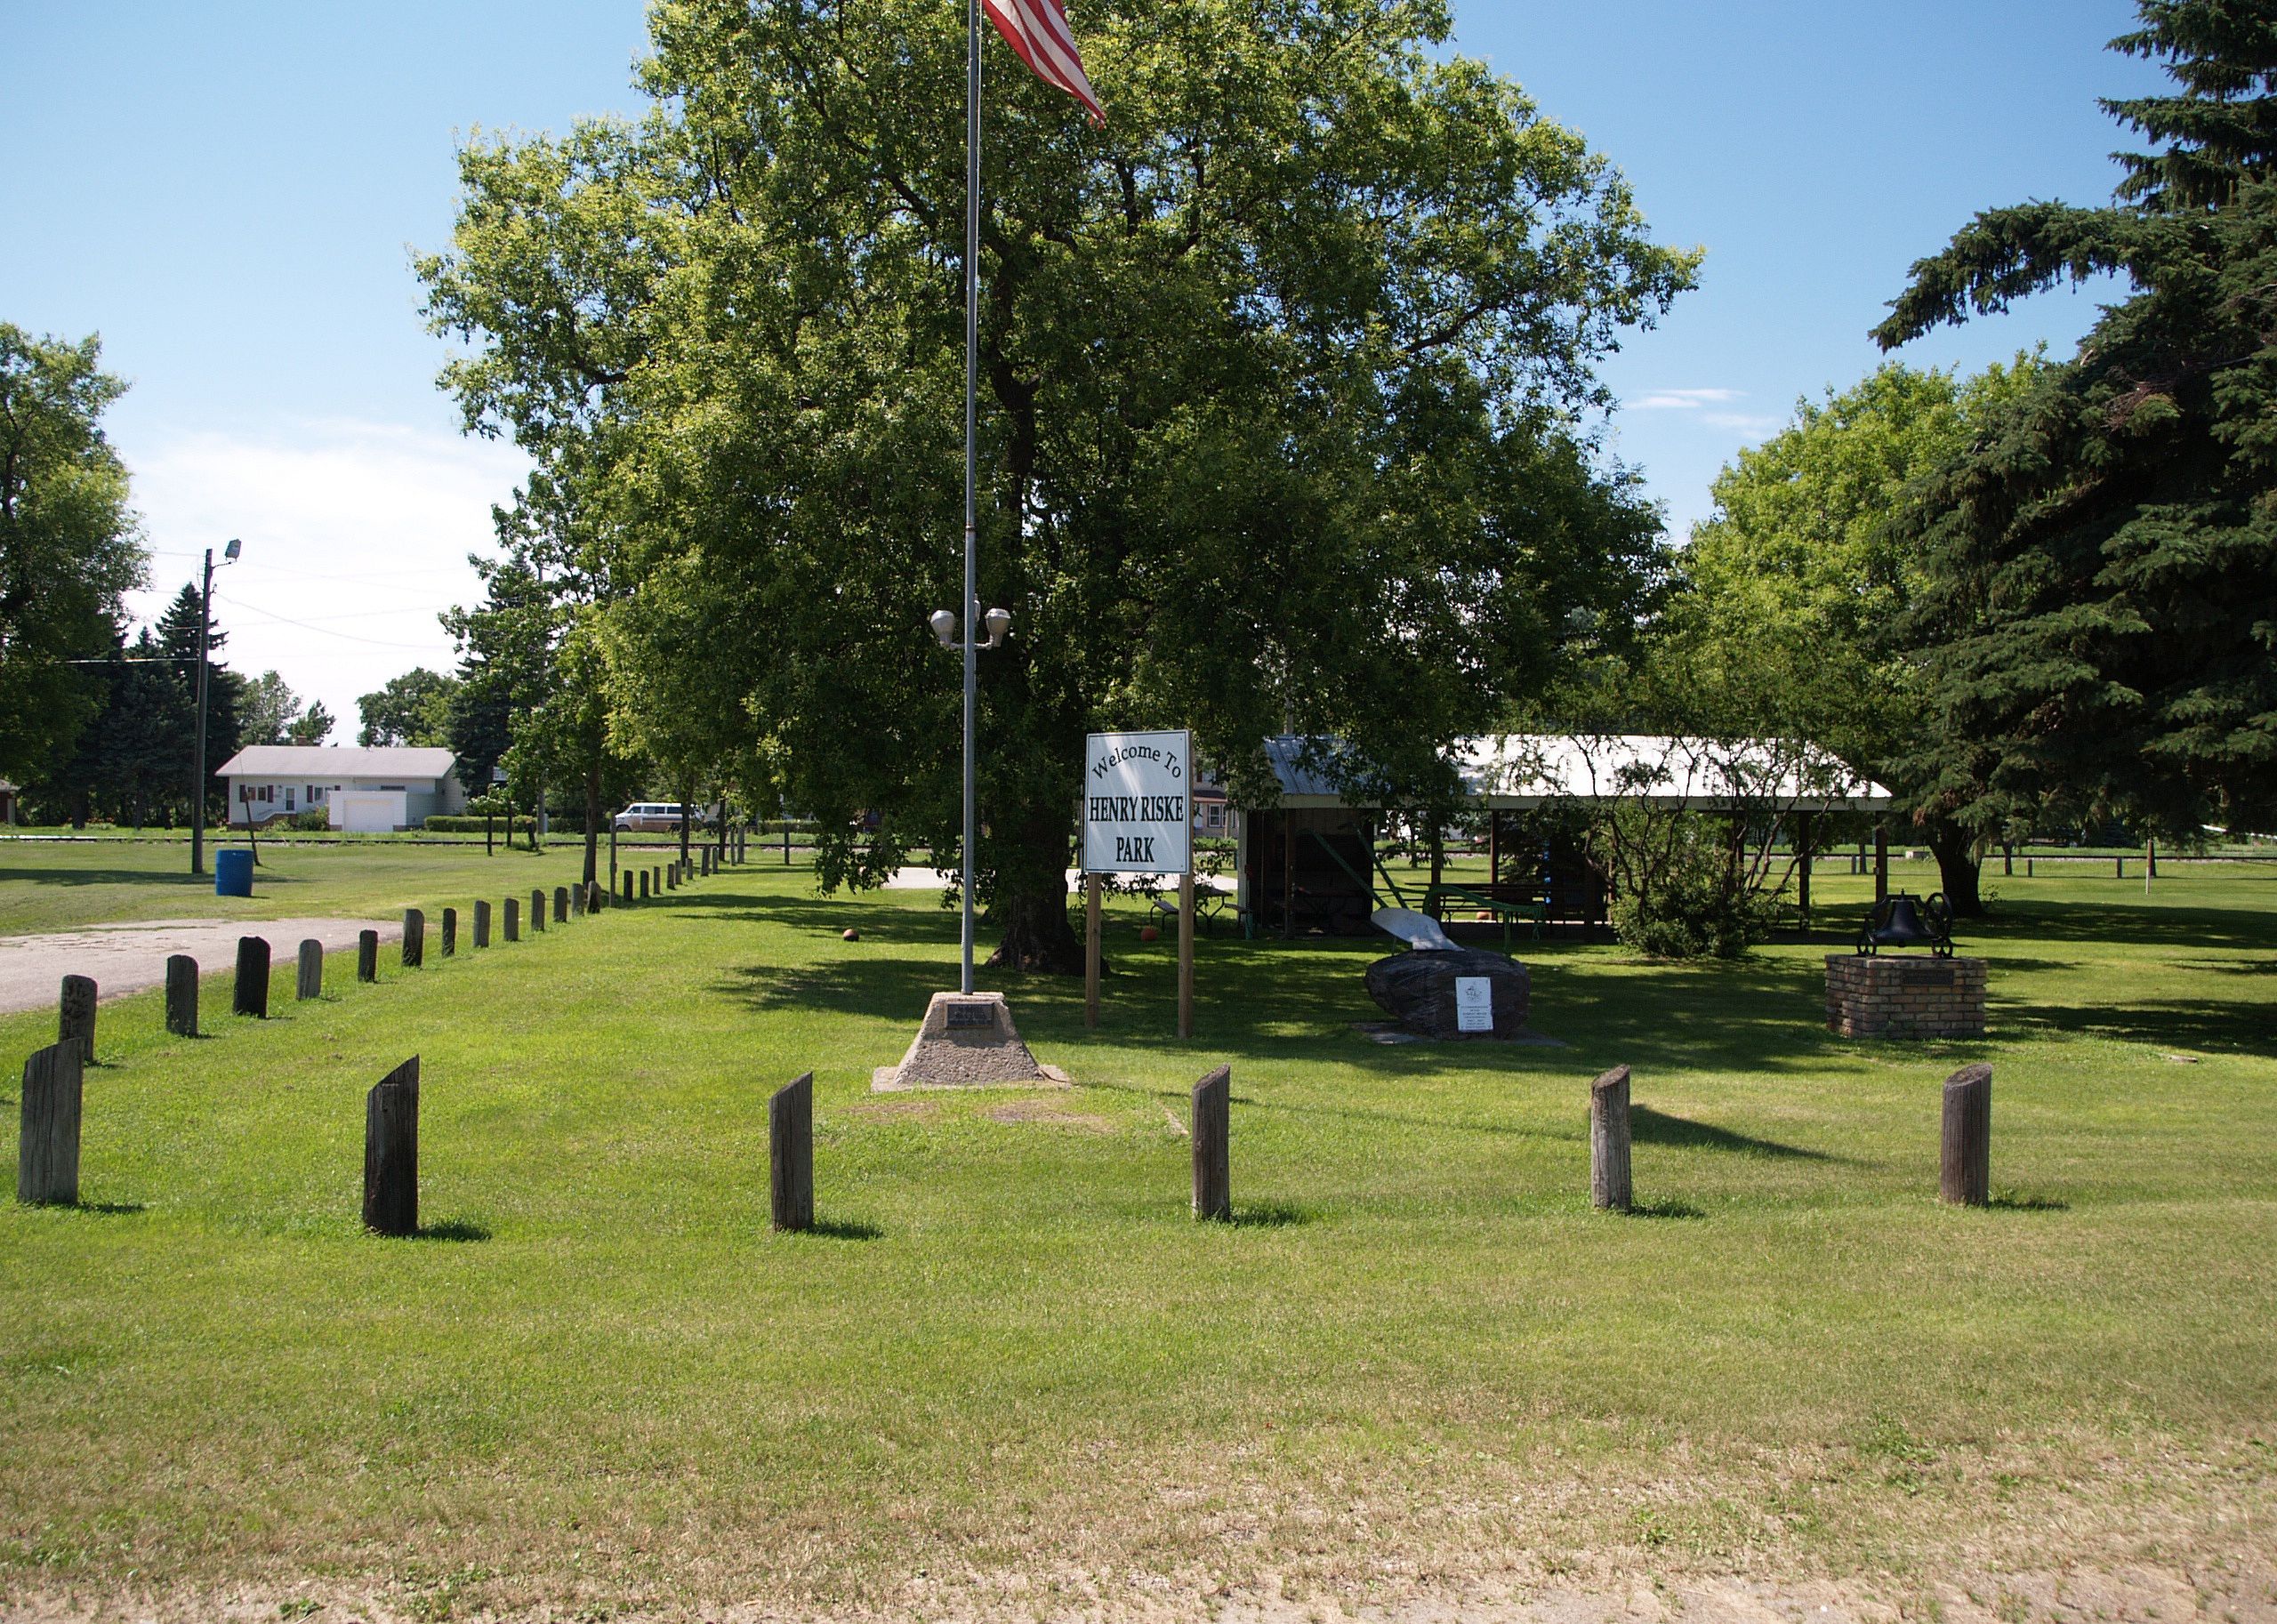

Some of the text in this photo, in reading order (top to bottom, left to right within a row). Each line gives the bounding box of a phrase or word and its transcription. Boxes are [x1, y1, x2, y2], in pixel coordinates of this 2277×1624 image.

[1093, 745, 1181, 779] Welcome To
[1090, 796, 1183, 822] HENRY RISKE
[1117, 837, 1155, 863] PARK
